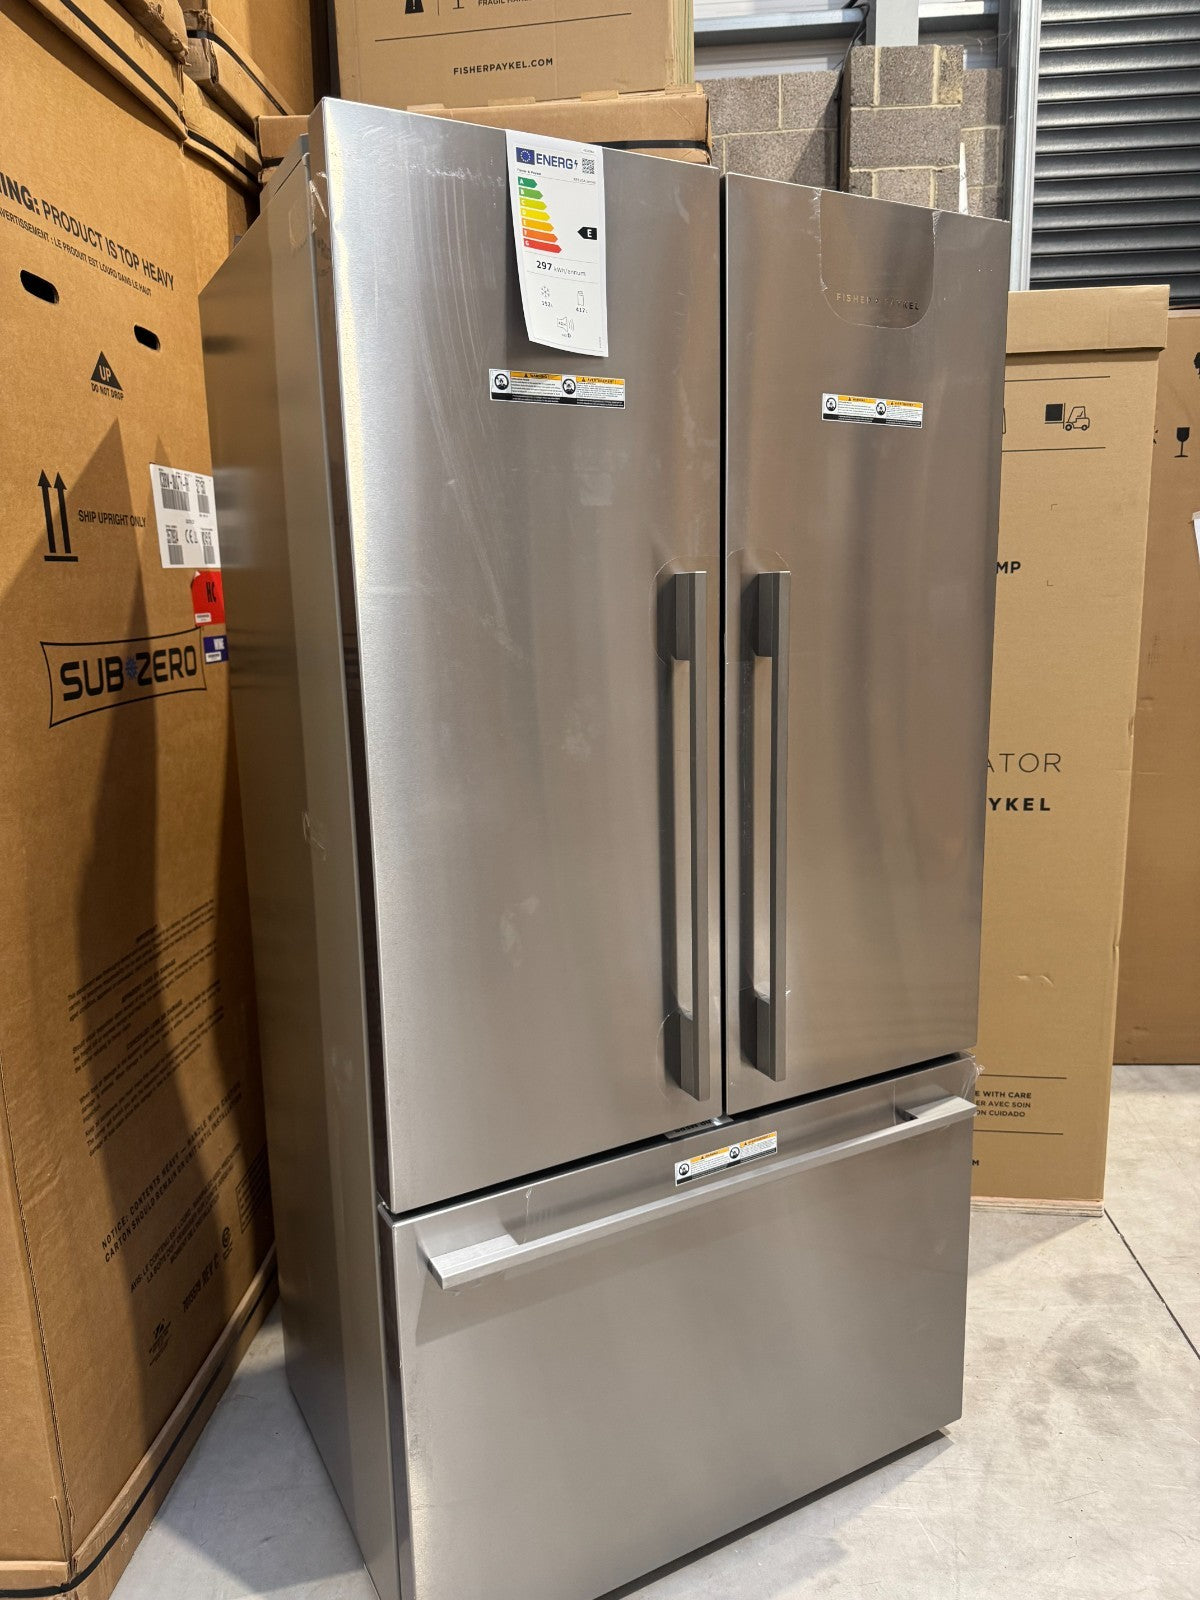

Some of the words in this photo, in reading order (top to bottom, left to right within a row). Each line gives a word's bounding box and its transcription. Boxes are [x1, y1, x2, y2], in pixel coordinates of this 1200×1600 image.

[453, 58, 553, 76] FISHERPAYKEL.COM
[0, 171, 41, 215] ING:
[41, 199, 103, 251] PRODUCT
[105, 237, 118, 260] IS
[117, 244, 140, 271] TOP
[141, 258, 174, 291] HEAVY
[587, 229, 593, 238] E
[536, 260, 553, 271] 297
[99, 365, 111, 382] UP
[78, 509, 96, 523] SHIP
[98, 511, 128, 526] UPRIGHT
[130, 515, 146, 527] ONLY
[60, 655, 124, 701] SUB
[136, 645, 197, 686] ZERO
[988, 797, 1051, 811] YKEL
[983, 1090, 1006, 1098] WITH
[105, 1226, 131, 1263] CARTON
